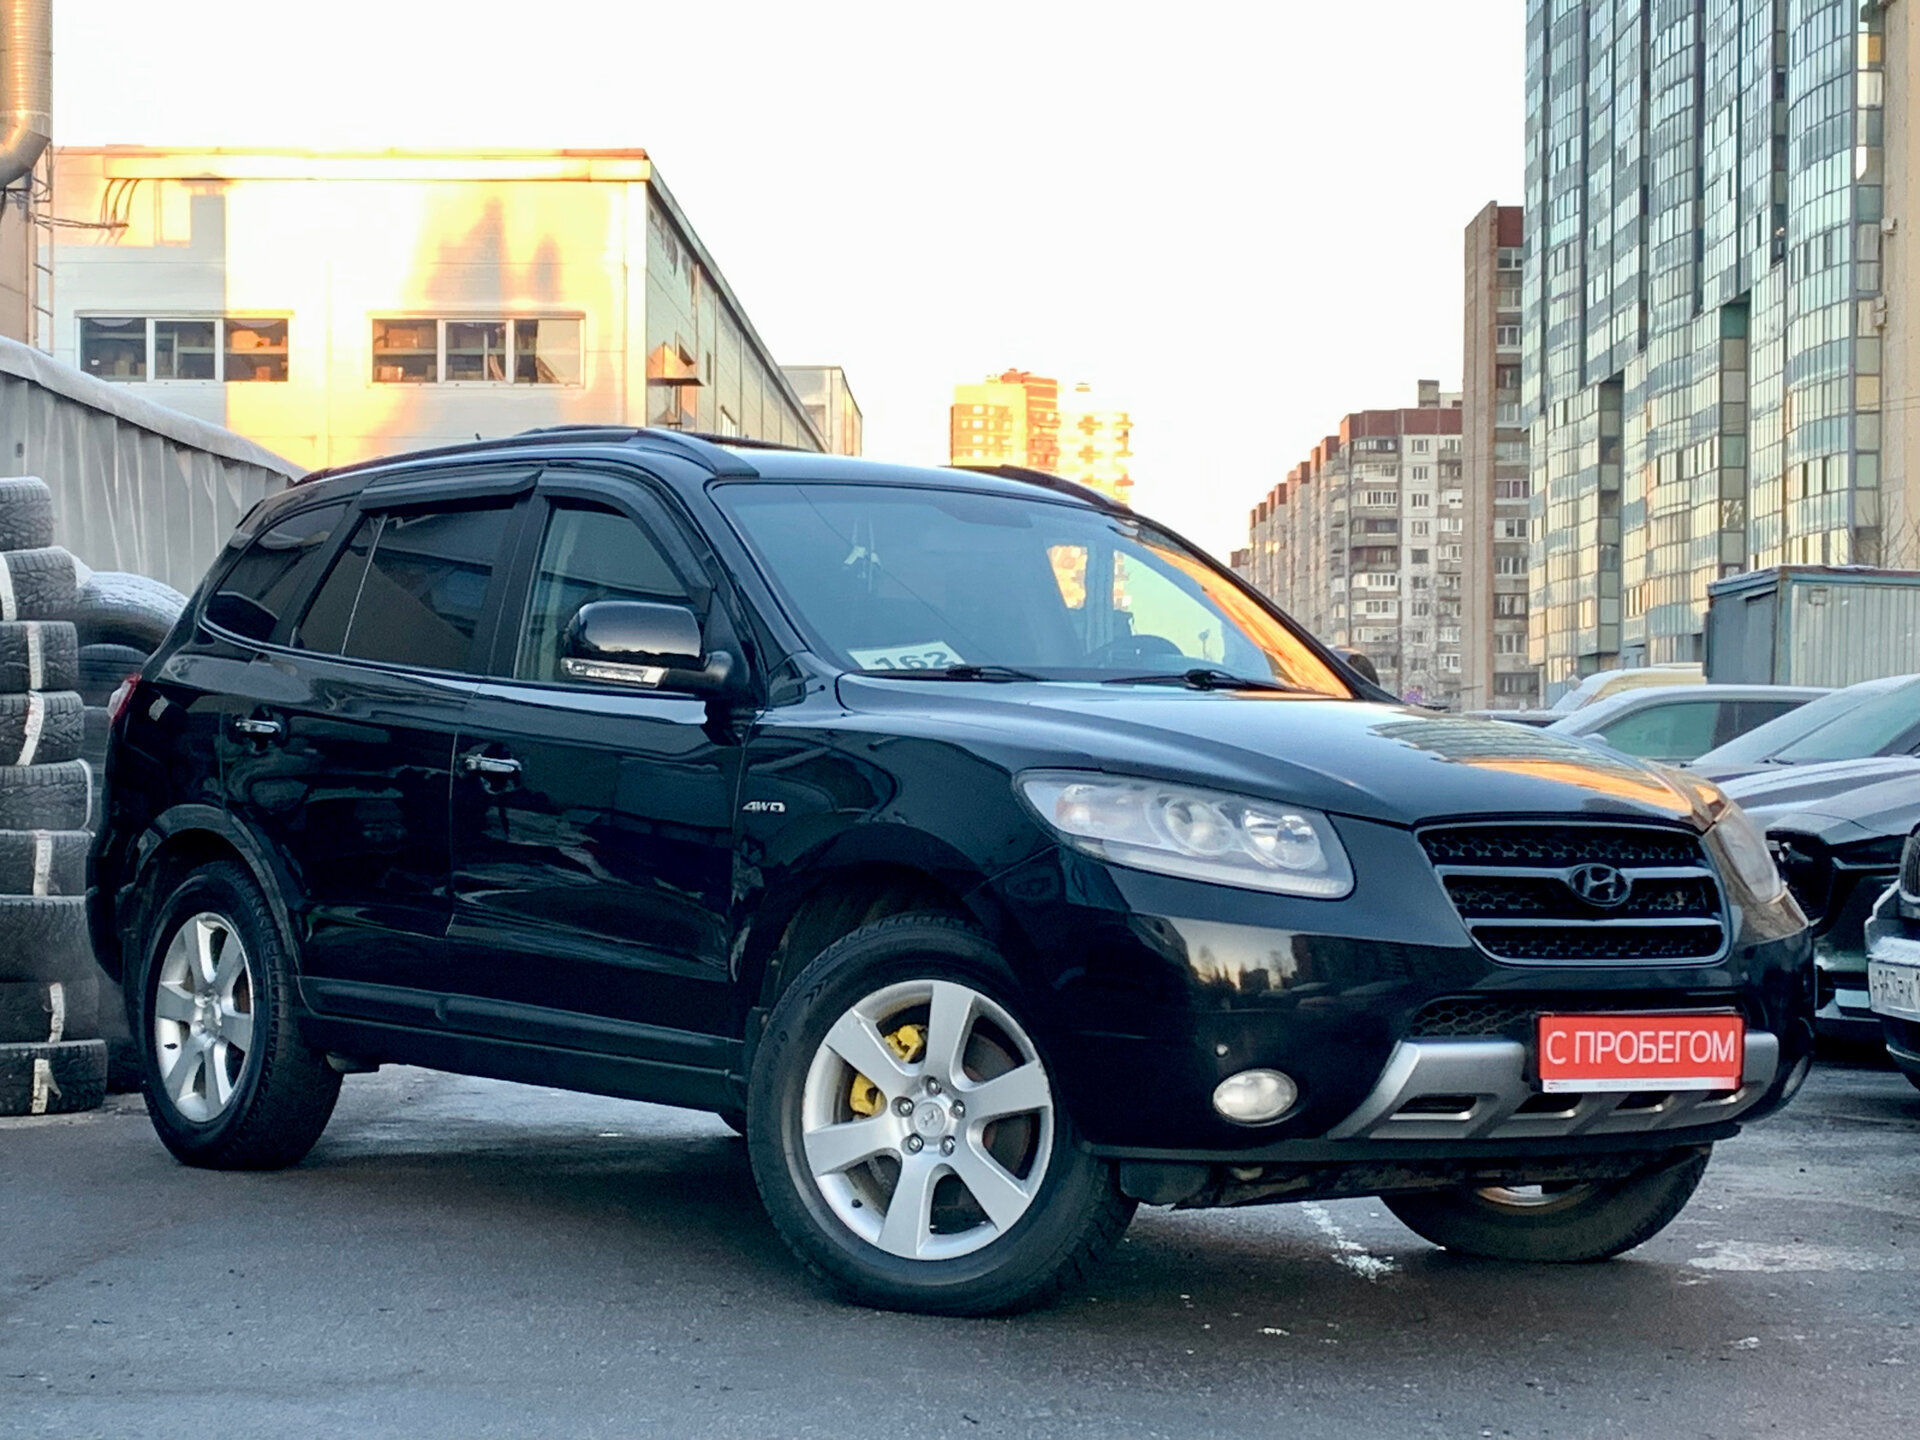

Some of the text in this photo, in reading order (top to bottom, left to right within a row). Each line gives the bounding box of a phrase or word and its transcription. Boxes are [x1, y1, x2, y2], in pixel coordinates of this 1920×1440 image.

[874, 651, 955, 670] 162
[742, 801, 786, 813] 4WD
[1546, 1030, 1735, 1065] С ПРОБЕГОМ
